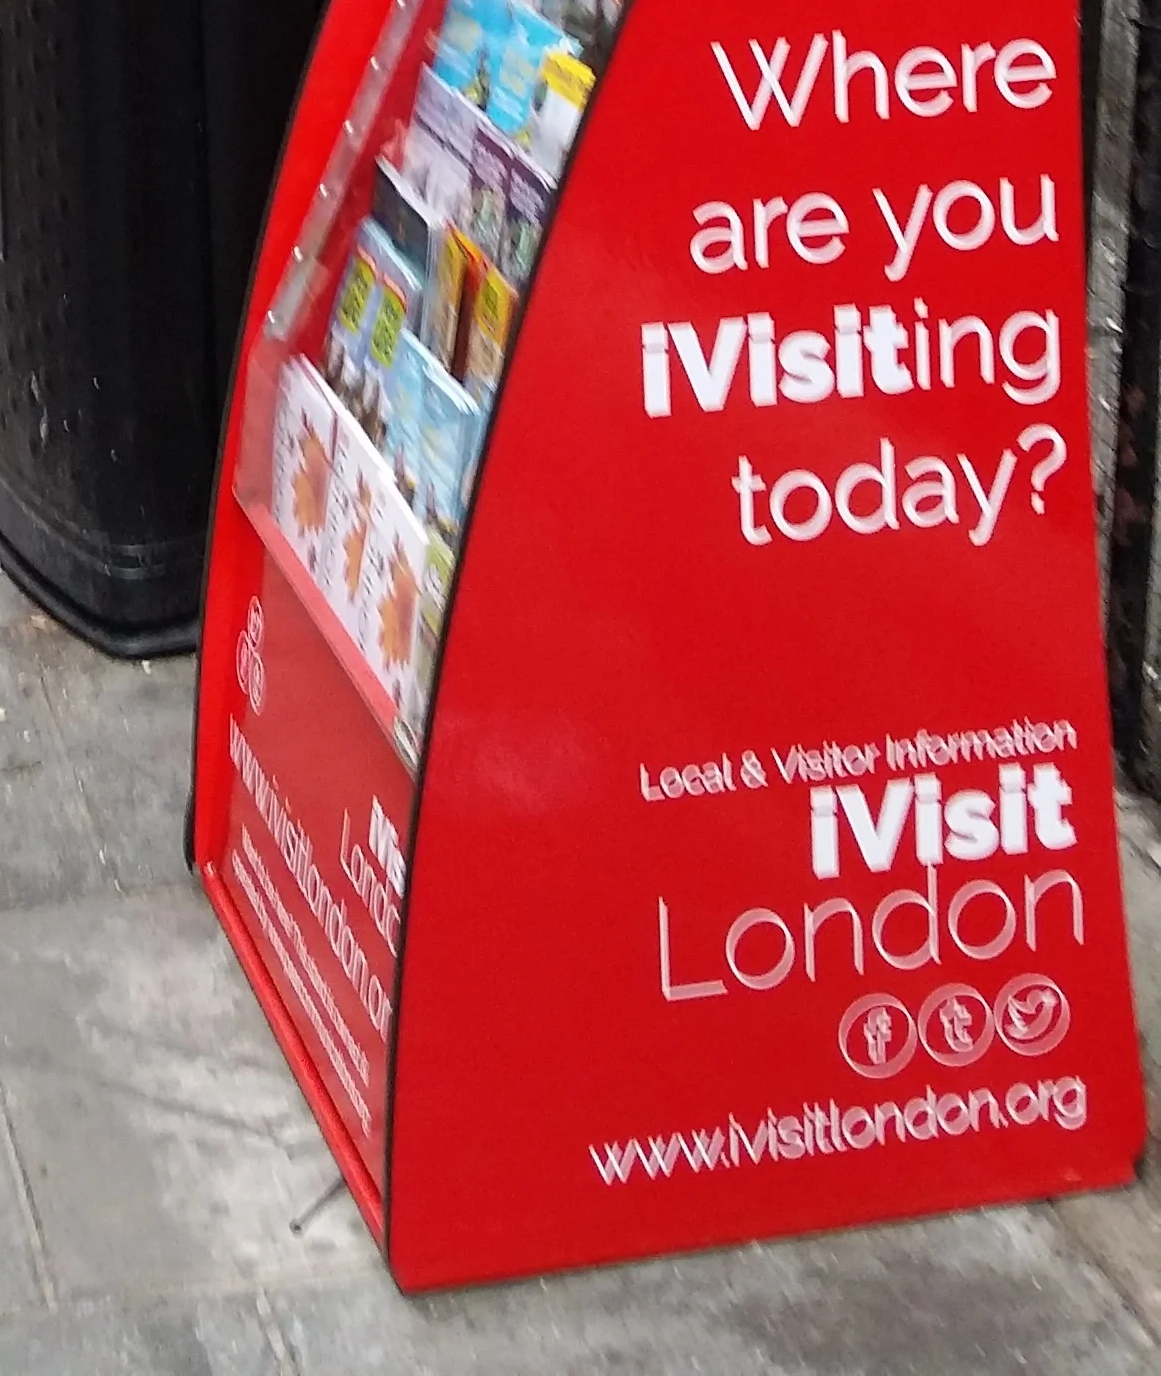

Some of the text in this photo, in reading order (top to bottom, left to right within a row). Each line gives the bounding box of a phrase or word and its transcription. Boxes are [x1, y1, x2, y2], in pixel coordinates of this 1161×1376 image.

[710, 29, 1057, 131] Where
[690, 174, 1059, 282] are you
[641, 297, 1061, 418] iVisiting
[731, 423, 1067, 546] today?
[640, 716, 1078, 802] Local & Visitor Information
[230, 713, 393, 1043] www.ivisitlondon.or
[809, 761, 1078, 880] iVisit
[659, 862, 1084, 1002] London
